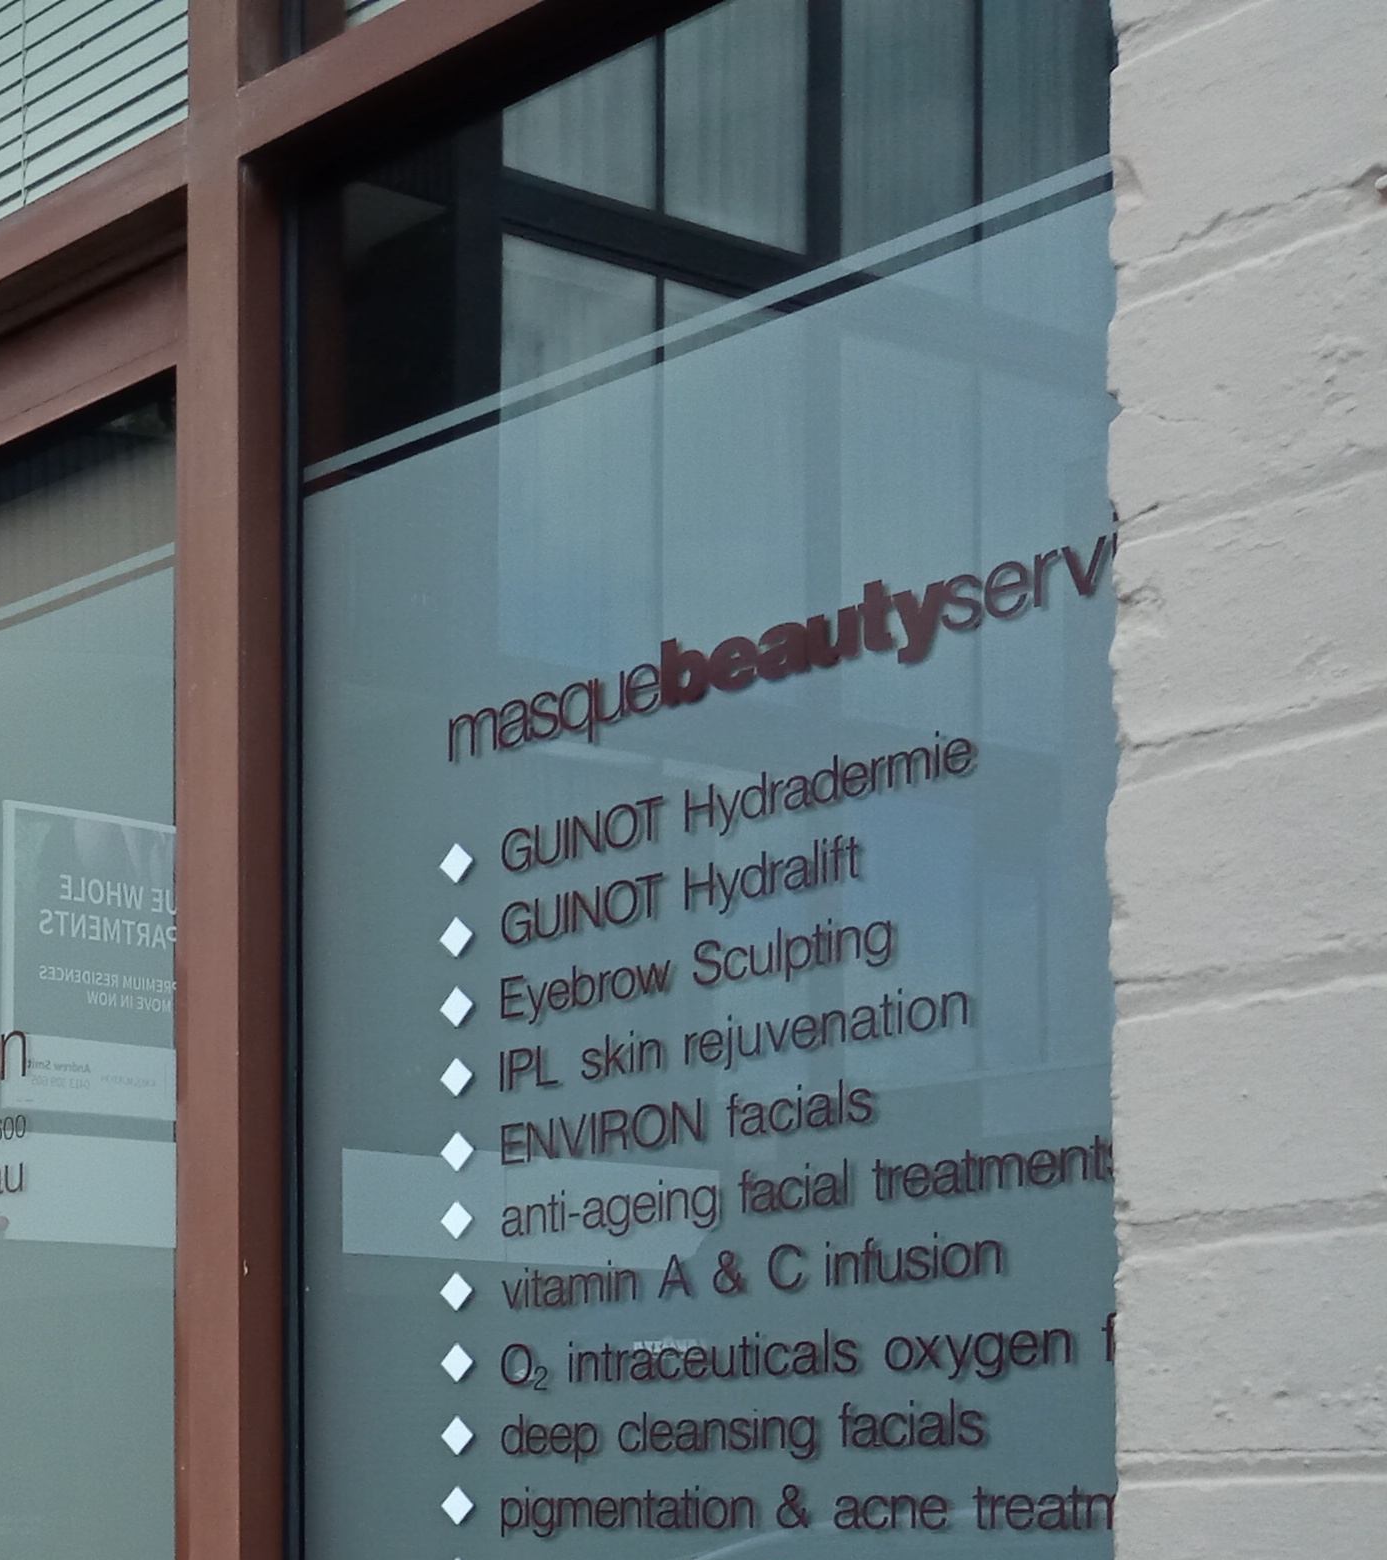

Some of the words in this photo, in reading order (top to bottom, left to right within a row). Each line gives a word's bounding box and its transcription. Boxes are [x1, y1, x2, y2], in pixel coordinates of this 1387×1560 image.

[501, 797, 663, 872] GUINOT
[684, 732, 974, 835] Hydradermie
[501, 873, 663, 945] GUINOT
[684, 835, 860, 912] Hydralift
[500, 961, 672, 1025] Eyebrow
[692, 917, 893, 984] Sculpting
[500, 1045, 558, 1091] IPL
[580, 1031, 661, 1080] skin
[684, 988, 968, 1068] rejuvenation
[500, 1098, 703, 1165] ENVIRON
[727, 1079, 873, 1137] facials
[500, 1179, 718, 1237] anti-ageing
[738, 1158, 848, 1214] facial
[502, 1261, 637, 1310] vitamin
[658, 1255, 690, 1299] A
[712, 1250, 744, 1294] &
[766, 1243, 805, 1291] C
[825, 1232, 1004, 1288] infusion
[567, 1331, 858, 1385] intraceuticals
[883, 1325, 1073, 1379] oxygen
[500, 1413, 598, 1461] deep
[618, 1410, 817, 1460] cleansing
[839, 1399, 986, 1448] facials
[500, 1486, 756, 1537] pigmentation
[775, 1485, 810, 1529] &
[833, 1495, 948, 1531] acne
